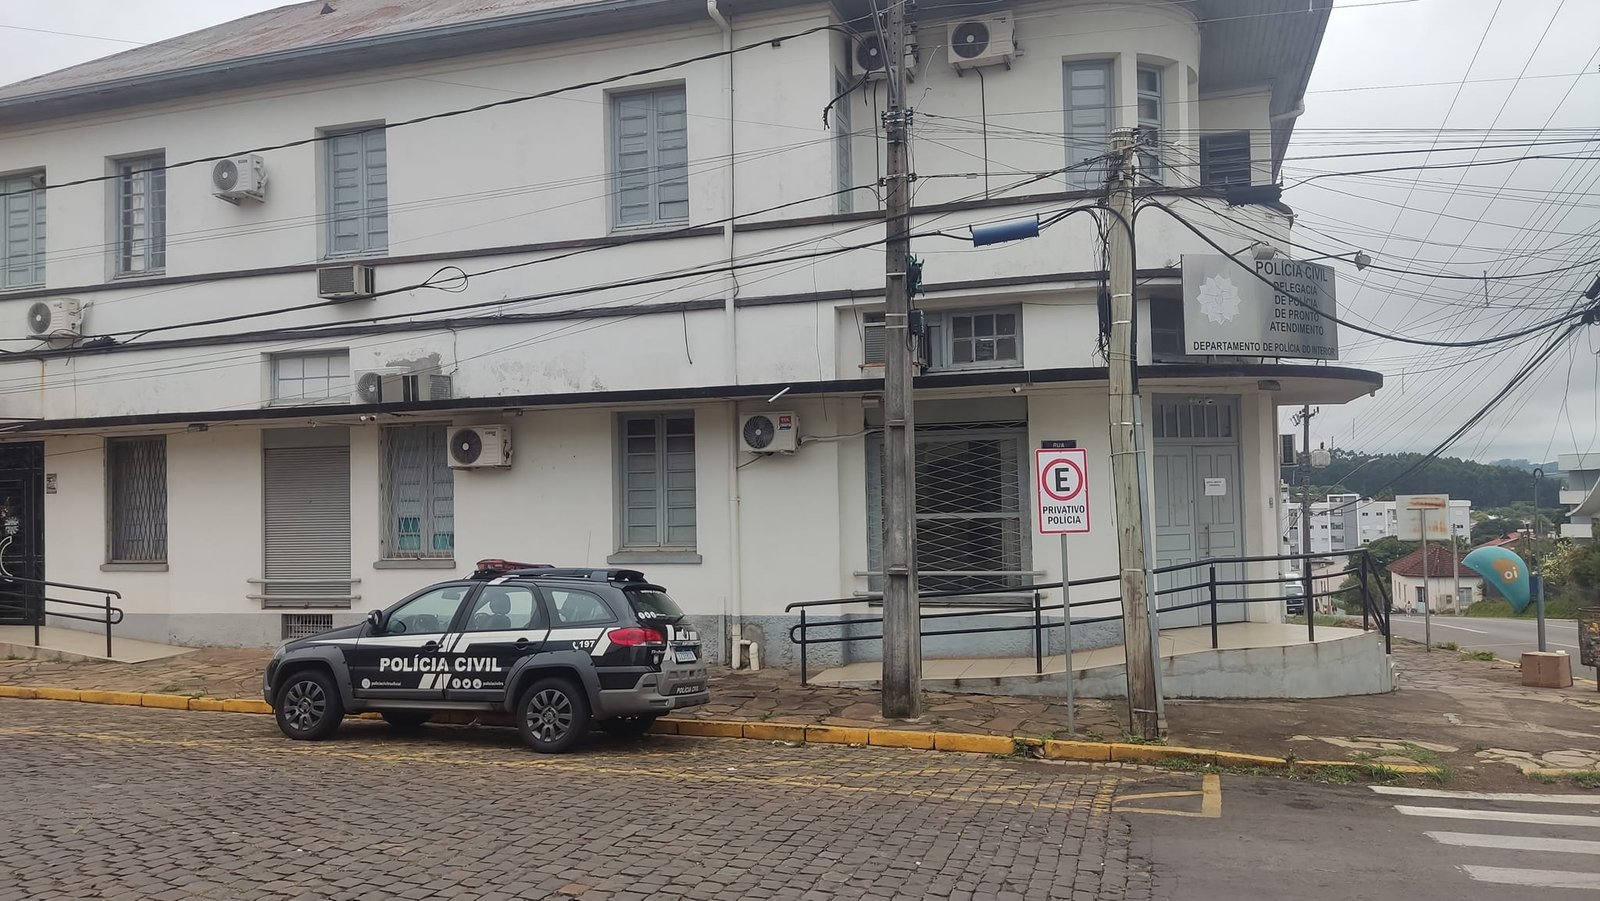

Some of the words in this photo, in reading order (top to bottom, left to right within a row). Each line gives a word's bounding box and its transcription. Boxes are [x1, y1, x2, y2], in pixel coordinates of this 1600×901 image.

[1255, 259, 1304, 278] POLÍCIA
[1304, 267, 1328, 282] CIVIL
[1274, 294, 1287, 305] DE
[1274, 308, 1287, 319] DE
[1288, 309, 1320, 322] PRONTO
[1269, 321, 1324, 336] ATENDIMENTO
[1193, 341, 1261, 351] DEPARTAMENTO
[1262, 342, 1273, 352] DE
[1274, 342, 1300, 353] POLÍCIA
[1301, 344, 1311, 354] DO
[1312, 345, 1336, 356] INTERIOR
[1054, 467, 1071, 492] E
[1042, 505, 1085, 515] PRIVATIVO
[1047, 513, 1082, 525] POLÍCIA
[1504, 566, 1518, 580] oi
[578, 640, 595, 648] 197
[379, 654, 449, 672] POLÍCIA
[454, 657, 502, 672] CIVIL
